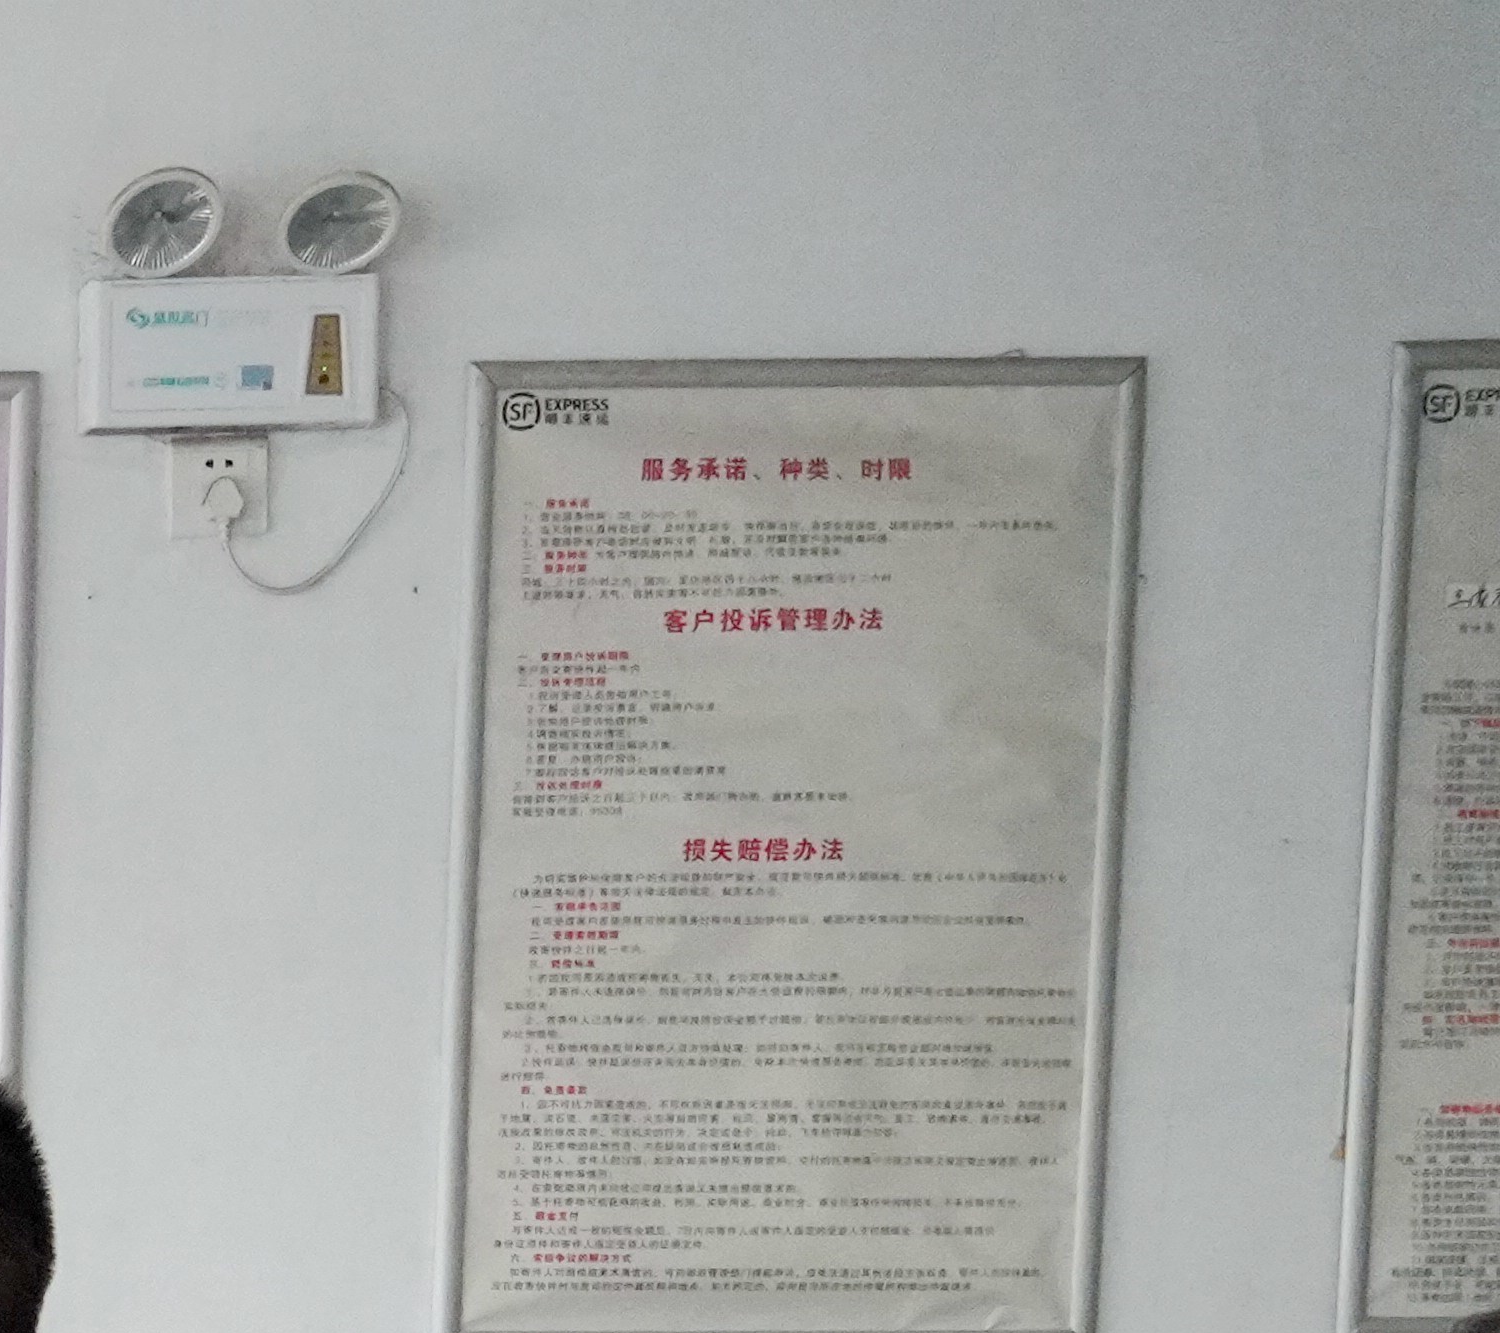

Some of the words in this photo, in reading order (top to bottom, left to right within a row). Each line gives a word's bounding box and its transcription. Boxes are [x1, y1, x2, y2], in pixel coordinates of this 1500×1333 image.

[545, 399, 609, 411] EXPRESS
[641, 457, 912, 482] 服务承诺、种类、时限
[663, 607, 884, 634] 客户投诉管理办法
[683, 837, 845, 862] 损失赔偿办法
